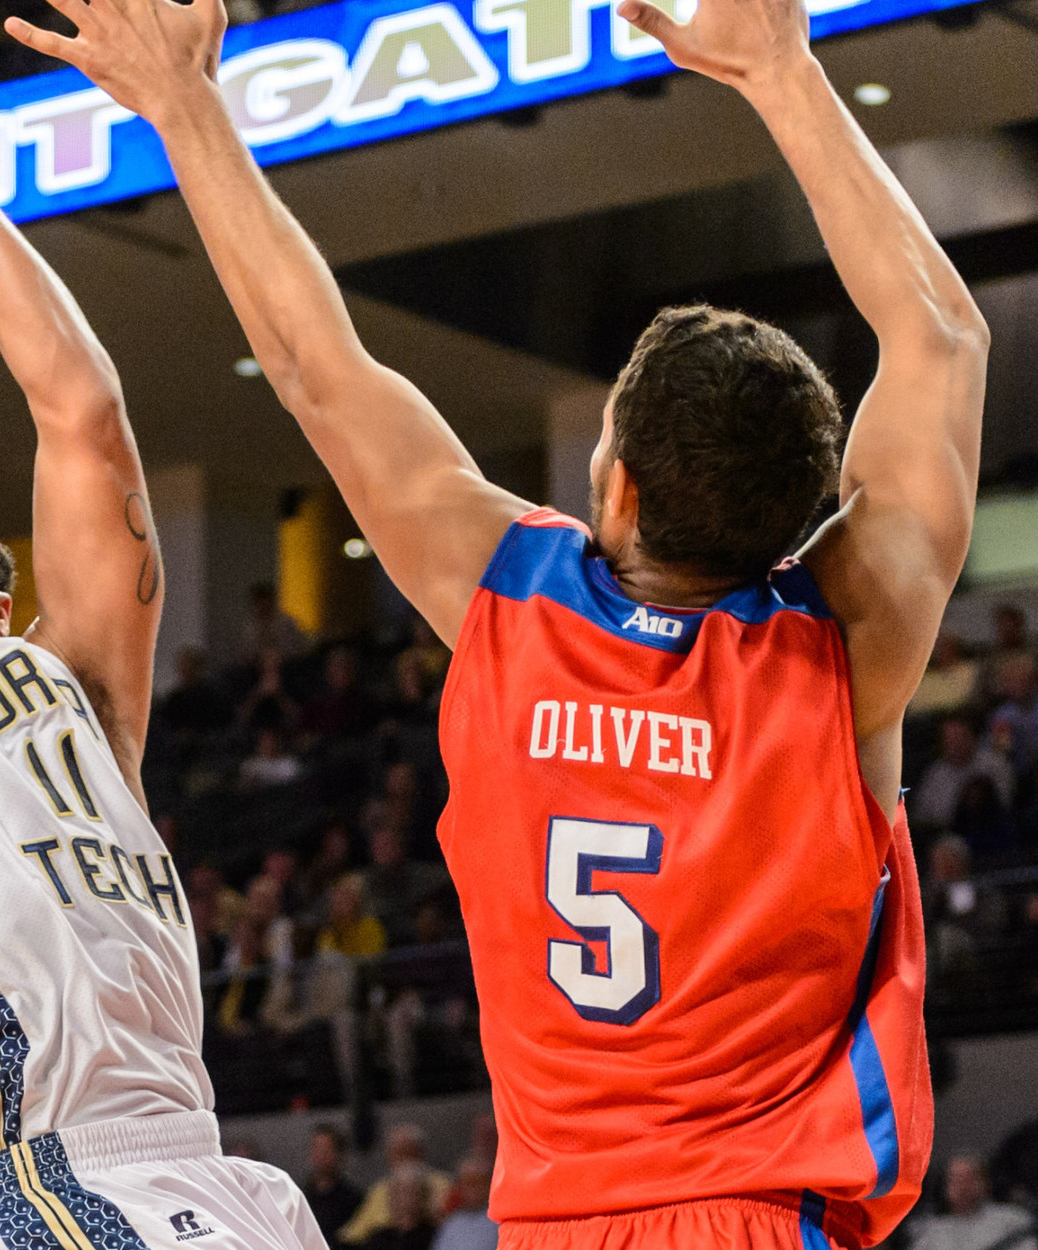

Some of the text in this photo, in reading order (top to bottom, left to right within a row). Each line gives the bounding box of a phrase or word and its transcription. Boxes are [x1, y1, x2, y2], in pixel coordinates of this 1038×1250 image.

[23, 729, 102, 822] 11
[529, 700, 712, 780] OLIVER
[18, 832, 187, 929] TECH
[545, 814, 664, 1026] 5
[175, 1226, 215, 1241] RUSSELL
